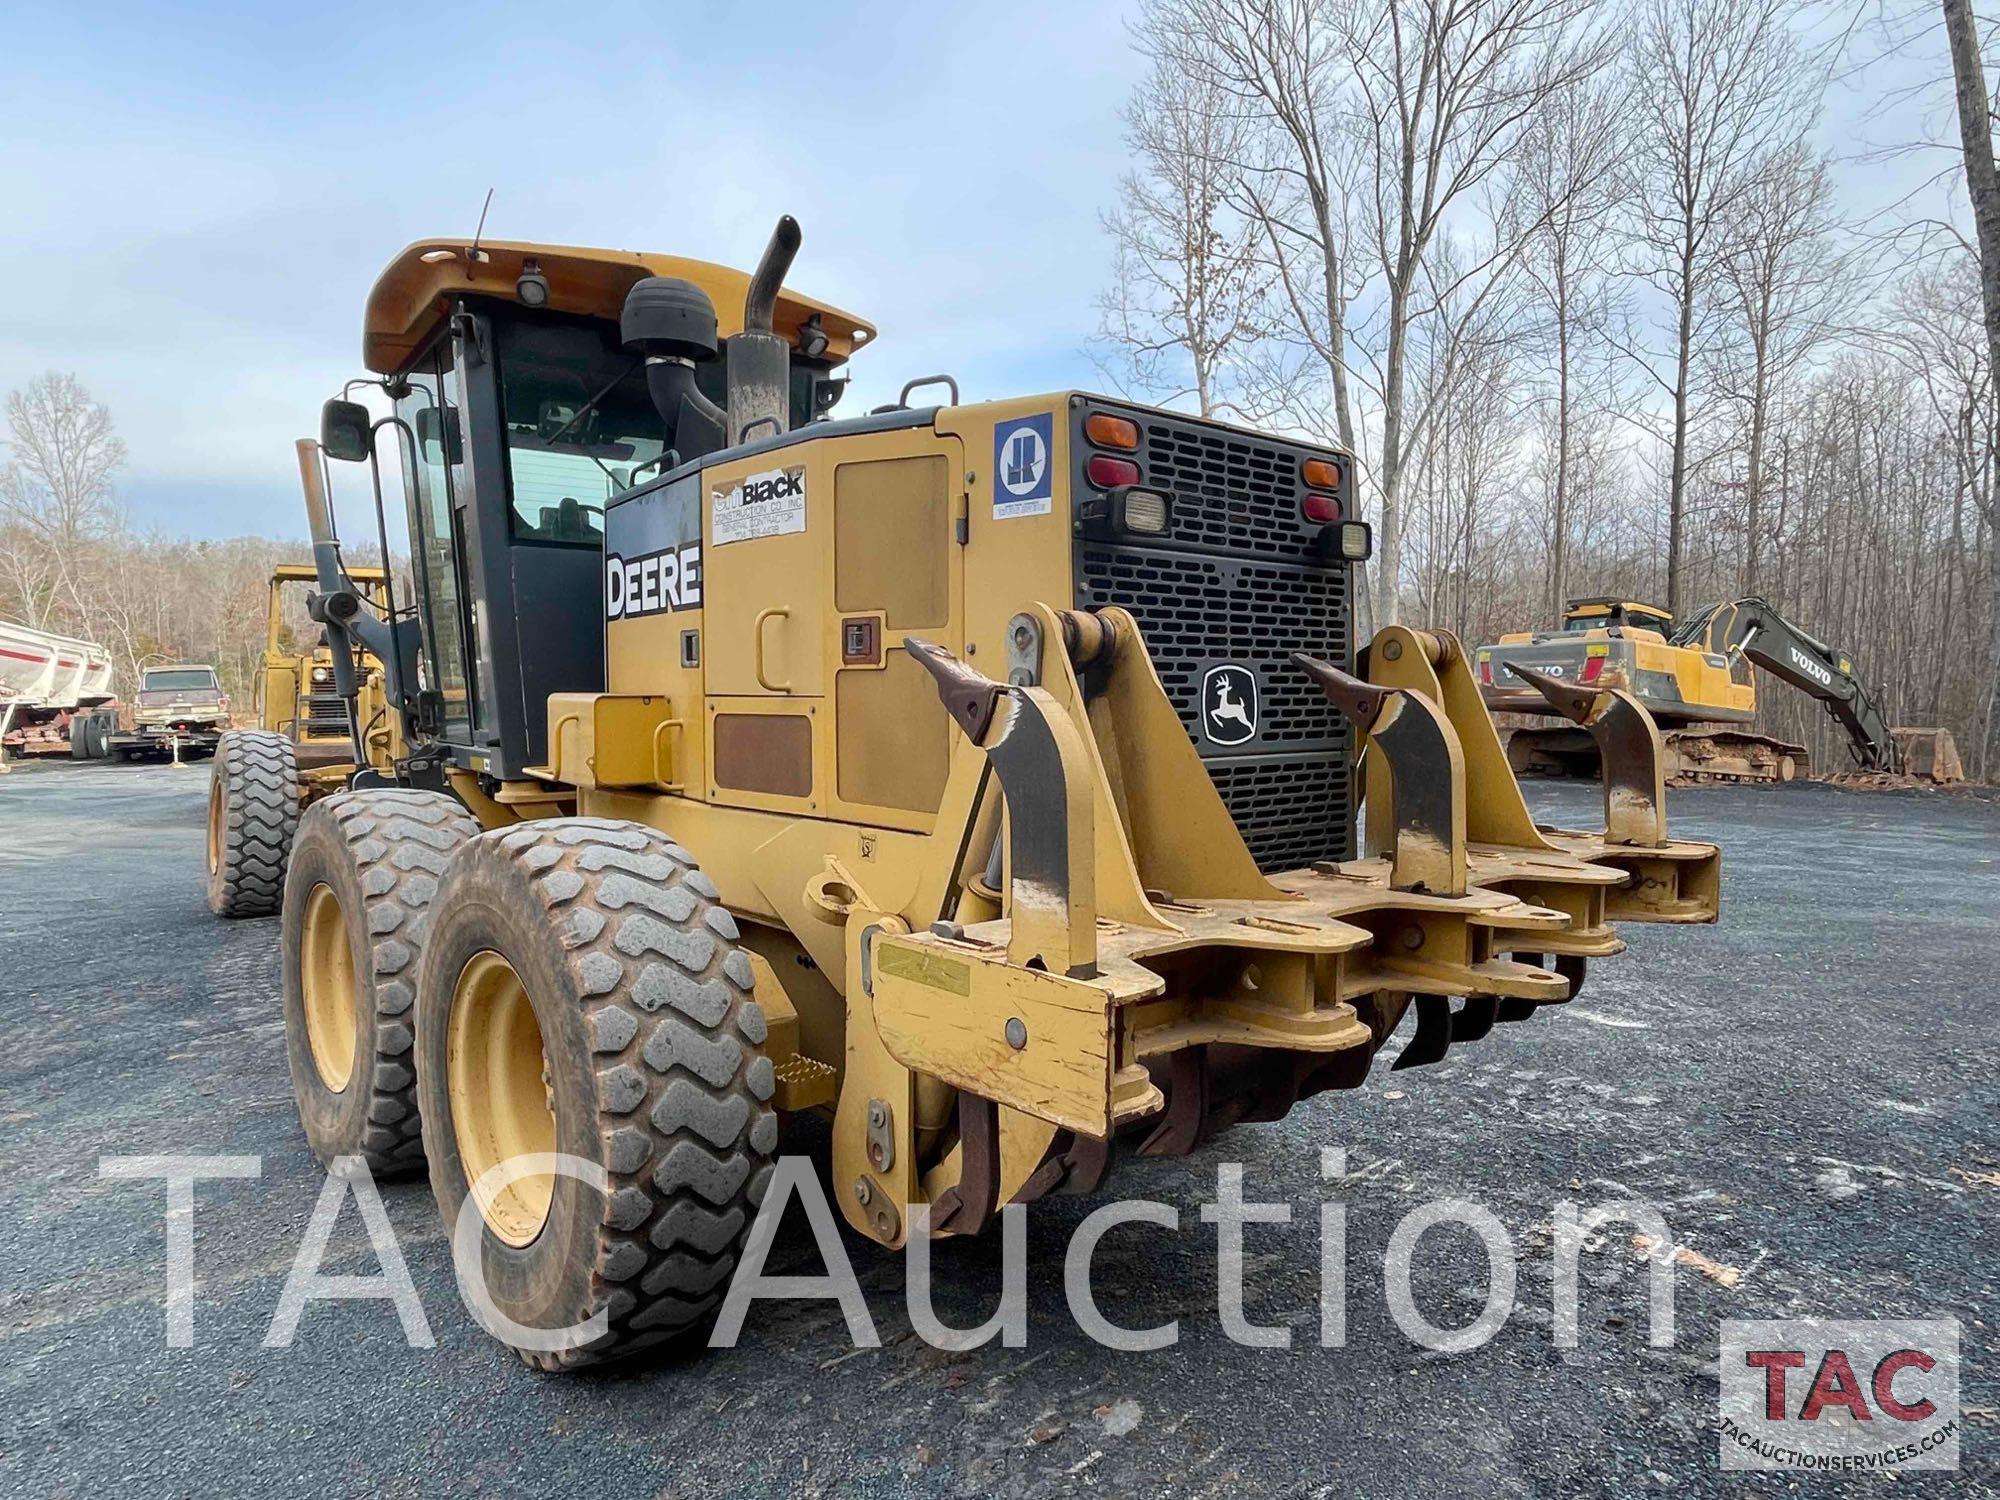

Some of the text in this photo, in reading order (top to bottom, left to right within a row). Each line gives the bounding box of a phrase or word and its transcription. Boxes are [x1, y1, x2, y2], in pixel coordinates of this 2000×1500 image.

[742, 472, 804, 506] Black
[714, 504, 767, 524] CONSTRUCTION
[607, 546, 700, 617] DEERE
[1790, 647, 1831, 685] VOLVO
